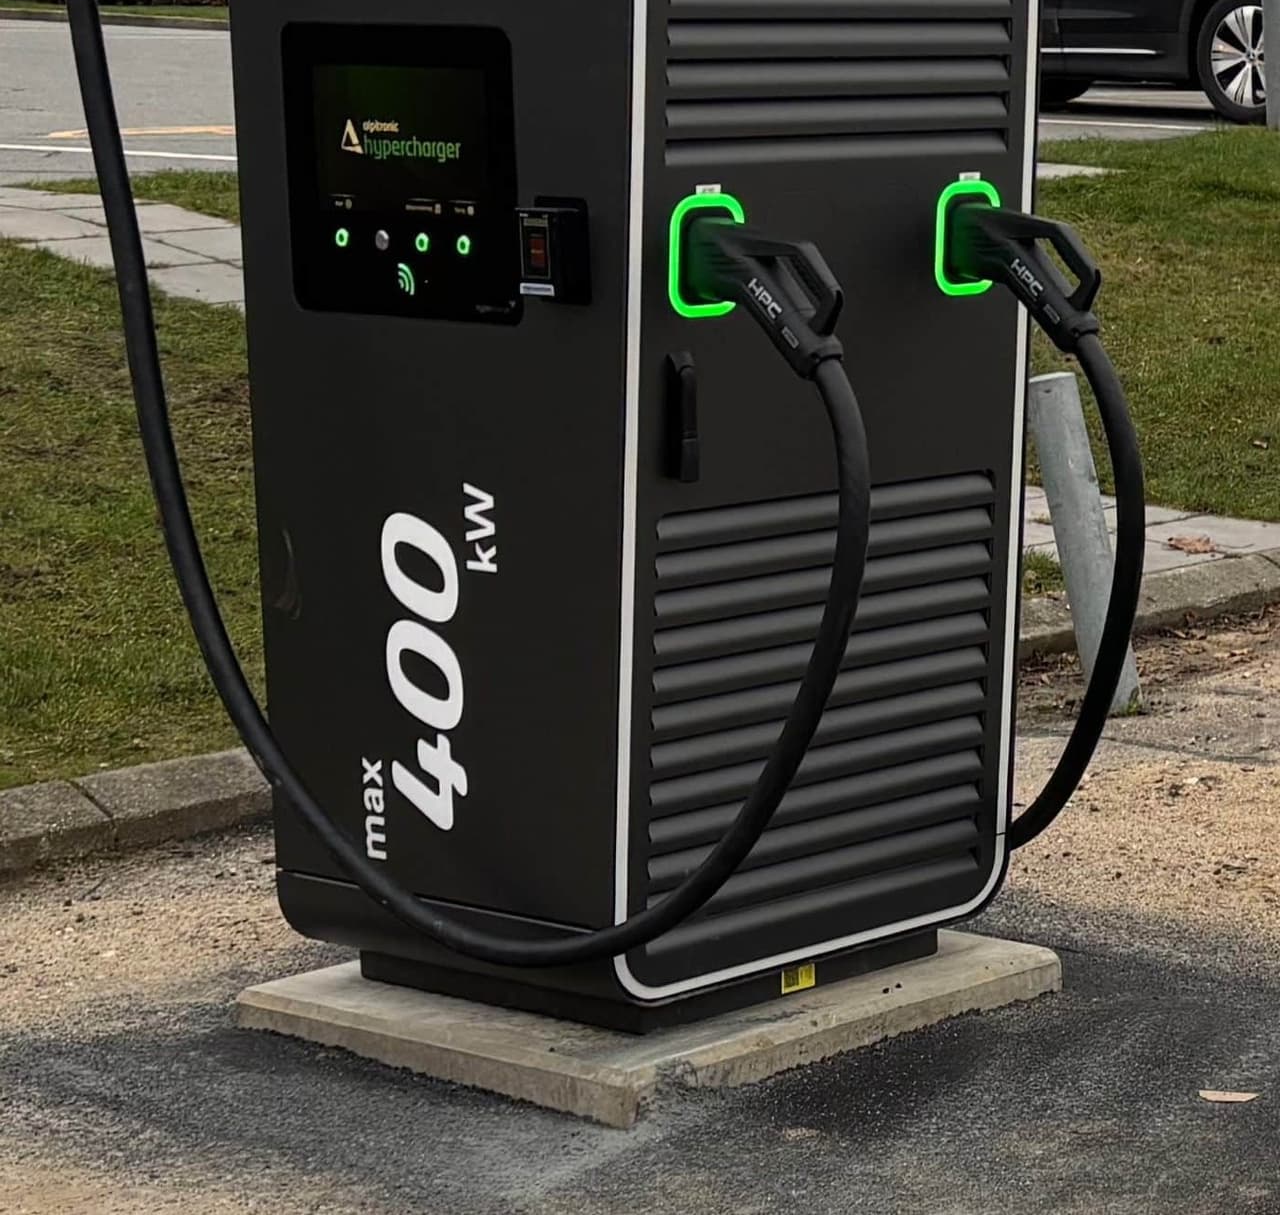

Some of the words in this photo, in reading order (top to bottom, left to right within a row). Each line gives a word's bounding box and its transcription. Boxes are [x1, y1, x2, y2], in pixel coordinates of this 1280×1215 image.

[363, 134, 461, 163] hypercharger
[1010, 258, 1044, 296] HPC
[748, 278, 782, 319] HPC
[361, 757, 388, 860] max
[381, 512, 468, 831] 400
[463, 482, 498, 573] kW
